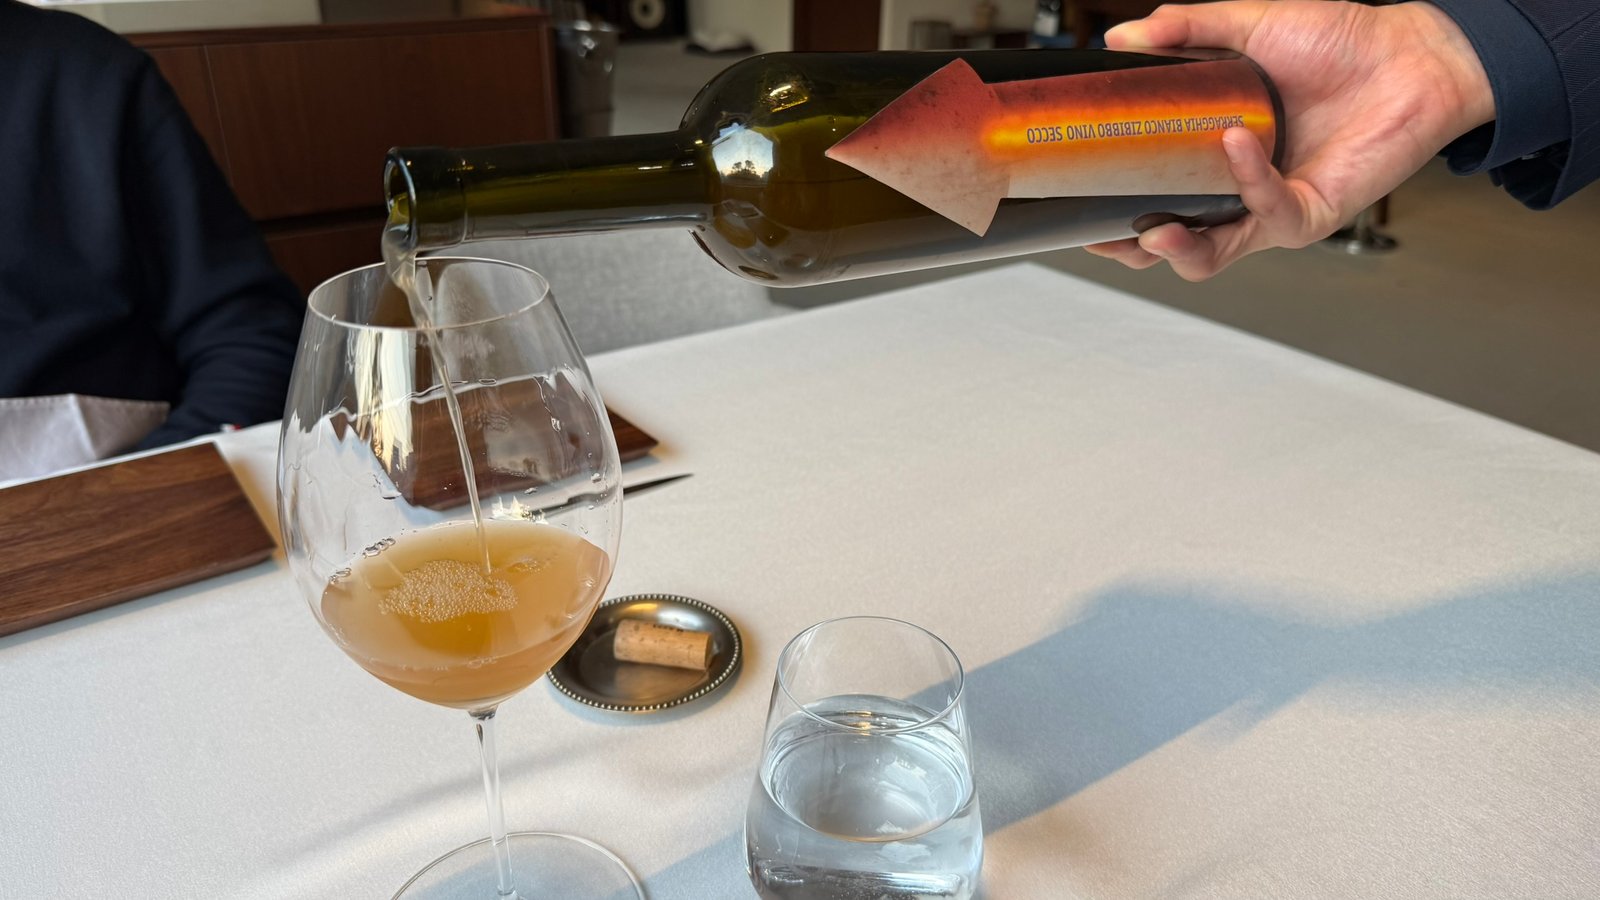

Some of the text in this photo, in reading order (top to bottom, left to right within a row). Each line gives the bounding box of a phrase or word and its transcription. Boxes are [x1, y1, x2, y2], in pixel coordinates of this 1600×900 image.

[1027, 115, 1244, 144] SERRAGGHIA BIANCO ZIBIBBO VINO SECCO
